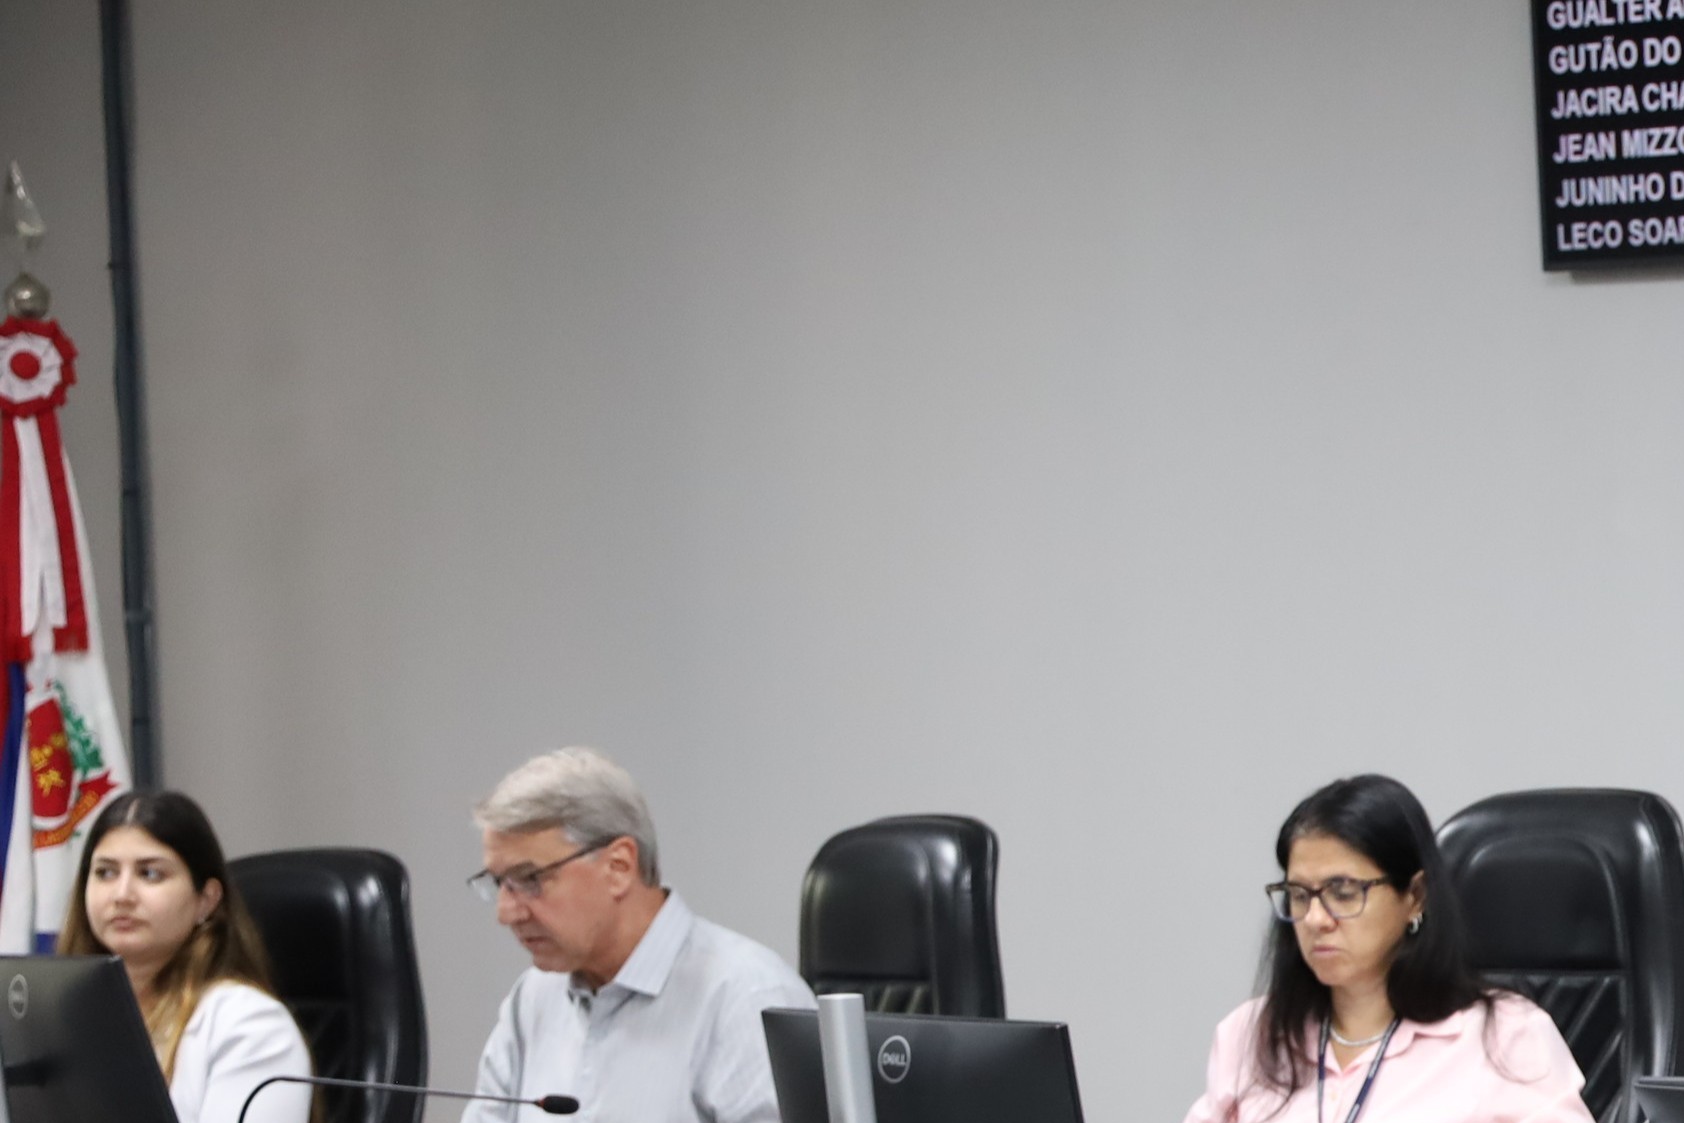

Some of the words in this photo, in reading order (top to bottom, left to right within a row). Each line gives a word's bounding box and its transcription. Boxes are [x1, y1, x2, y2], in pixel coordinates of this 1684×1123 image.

[1547, 0, 1662, 30] GUALTER
[1549, 35, 1639, 75] GUTÃO
[1643, 36, 1682, 67] DO
[1551, 85, 1639, 119] JACIRA
[1552, 131, 1616, 164] JEAN
[1556, 170, 1665, 207] JUNINHO
[1557, 220, 1624, 251] LECO
